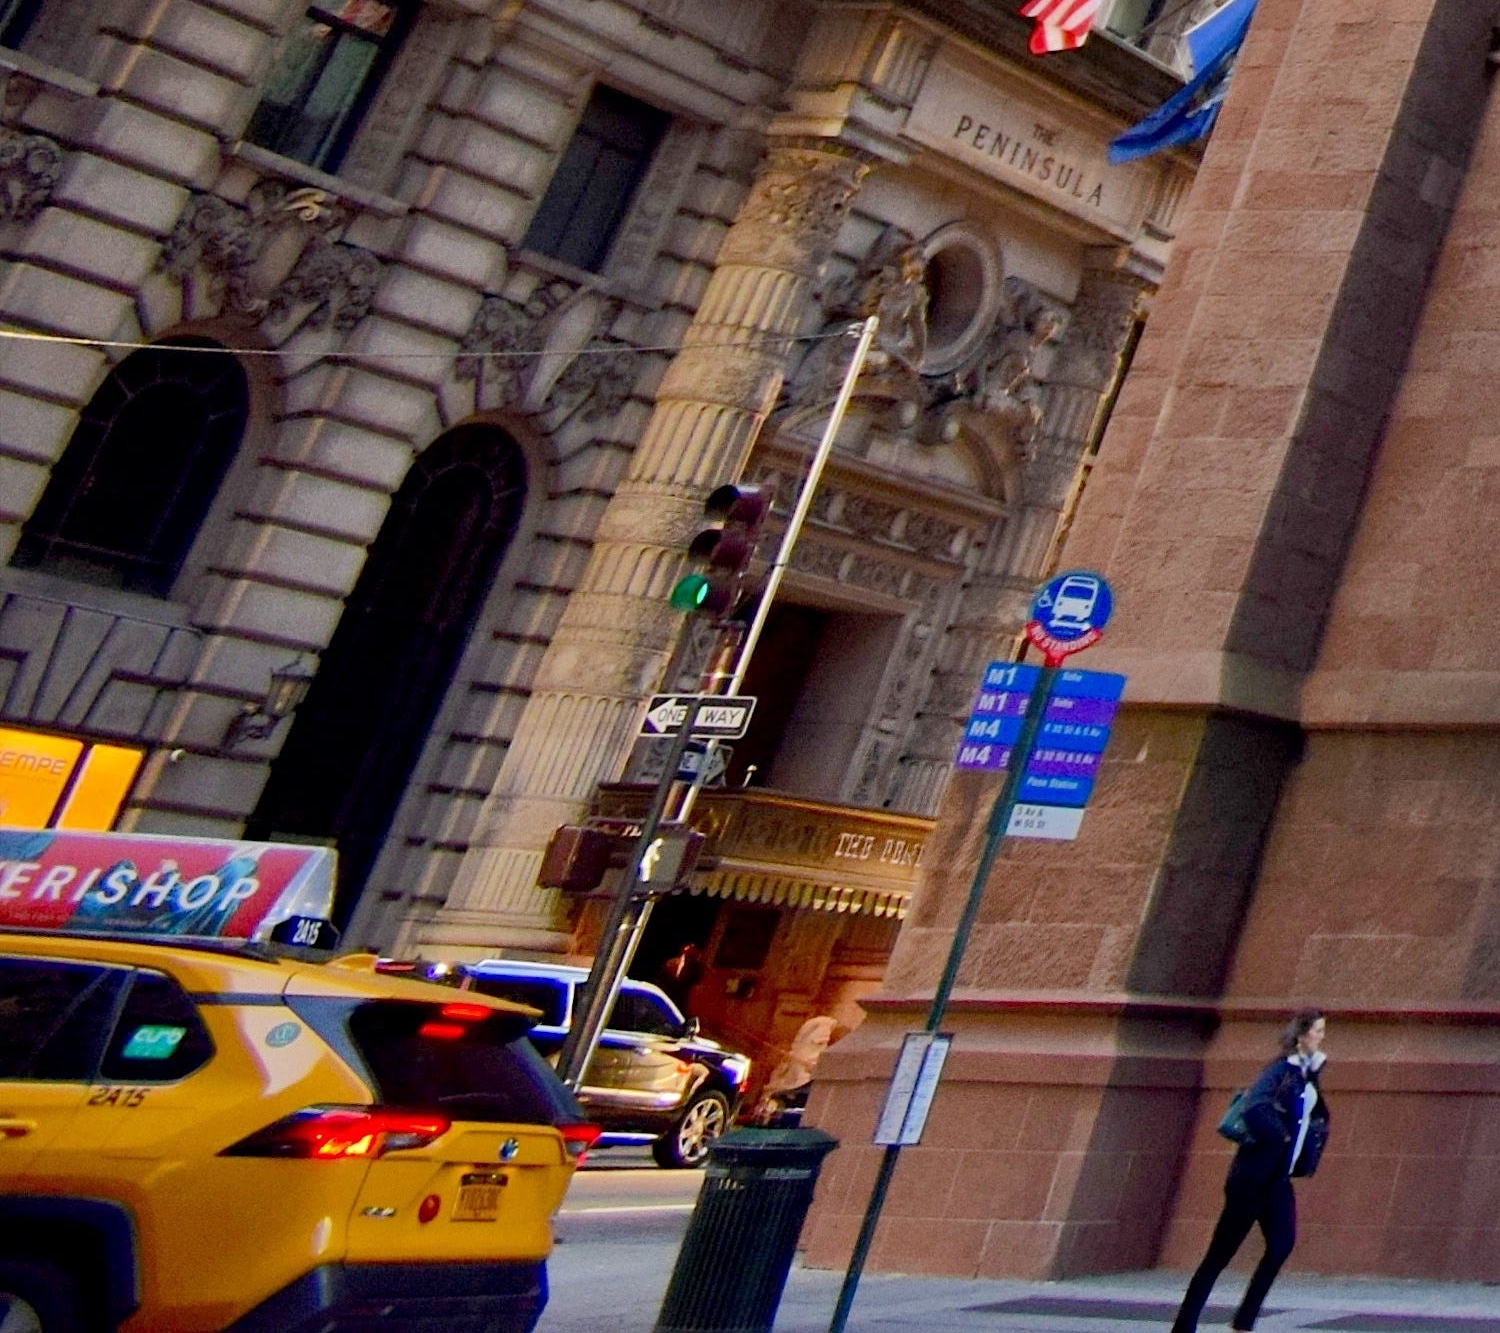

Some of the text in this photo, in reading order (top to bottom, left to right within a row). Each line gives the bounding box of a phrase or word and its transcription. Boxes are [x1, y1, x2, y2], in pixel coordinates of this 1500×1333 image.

[1033, 123, 1058, 147] THE
[952, 114, 1104, 208] PENINSULA
[988, 668, 1018, 686] M1
[979, 694, 1008, 712] M1
[657, 708, 740, 724] ONE WAY
[970, 720, 1001, 739] M4
[961, 747, 991, 765] M4
[834, 832, 876, 860] THE
[291, 918, 321, 947] 2A15
[86, 1087, 151, 1109] 2A15
